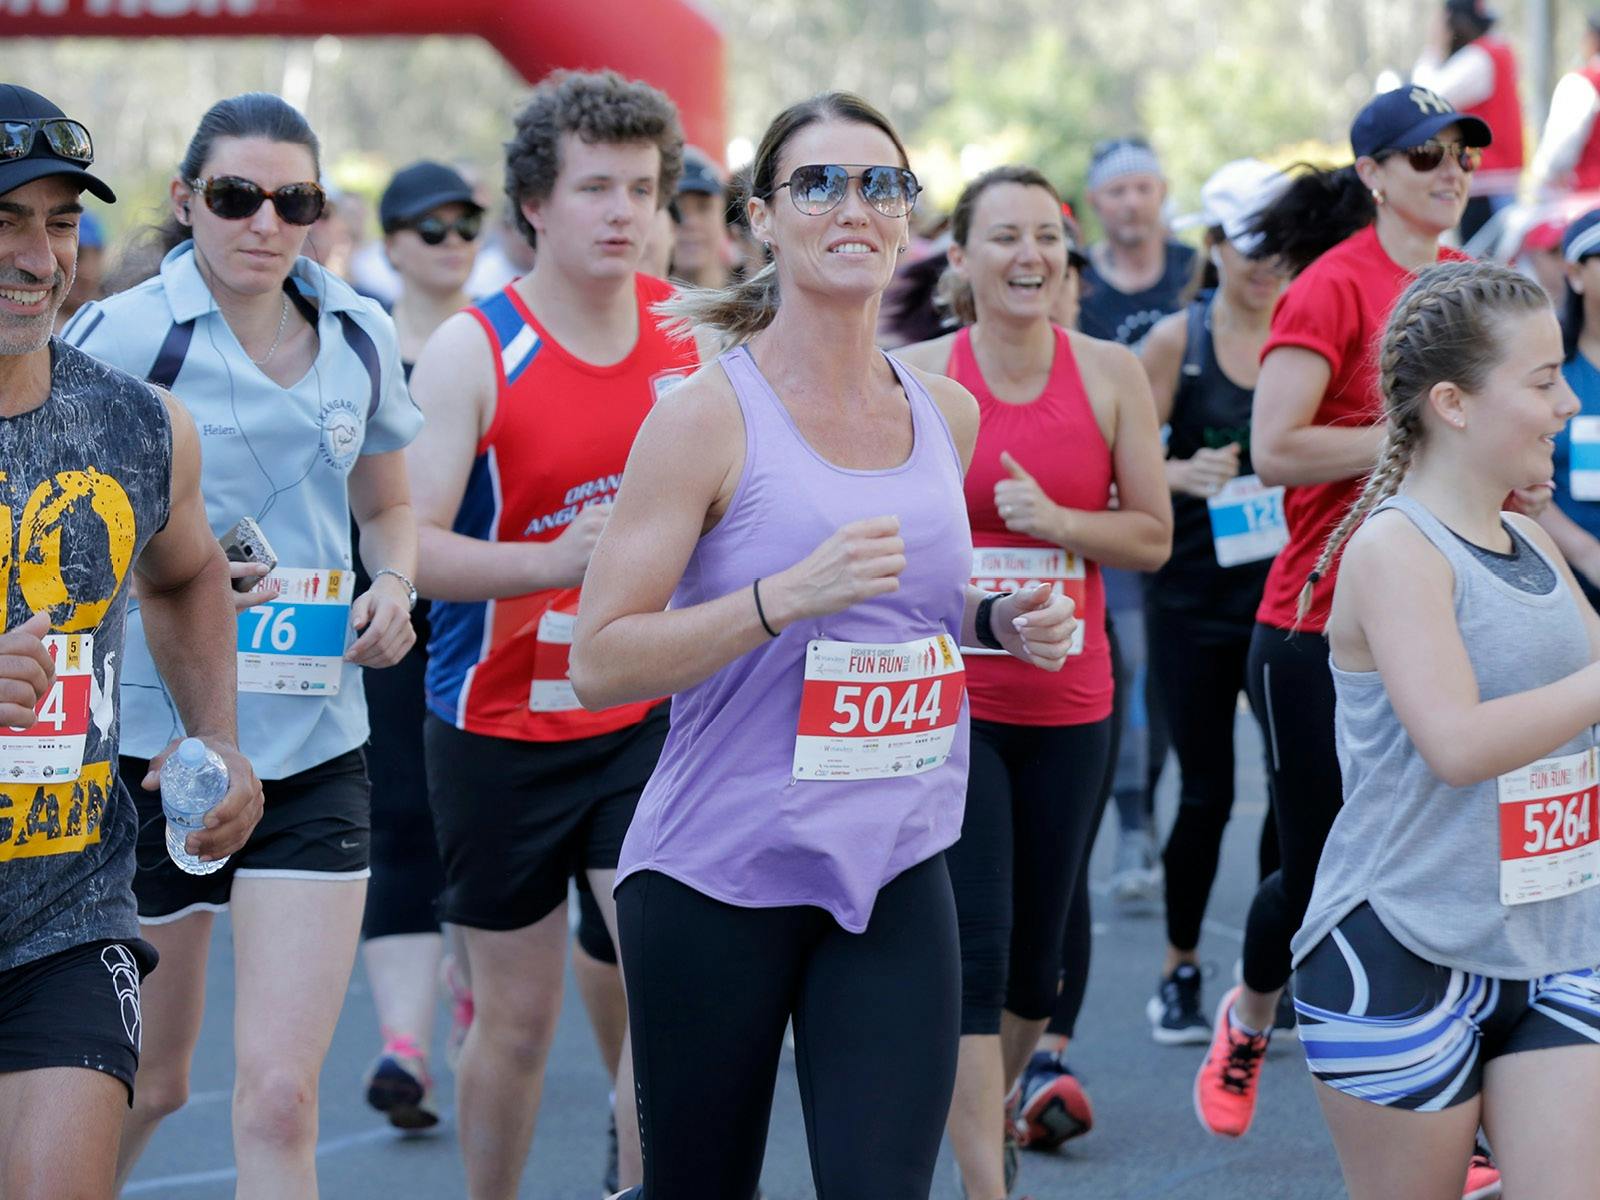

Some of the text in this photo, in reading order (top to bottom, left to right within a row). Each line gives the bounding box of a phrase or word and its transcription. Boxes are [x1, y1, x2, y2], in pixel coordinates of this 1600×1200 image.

[203, 424, 236, 436] Helen
[329, 576, 339, 589] 10
[249, 605, 297, 651] 76
[69, 641, 77, 653] 5
[68, 654, 79, 662] km
[849, 656, 875, 673] FUN
[878, 656, 903, 673] RUN
[829, 680, 943, 734] 5044
[1530, 772, 1549, 791] FUN
[1523, 793, 1591, 854] 5264
